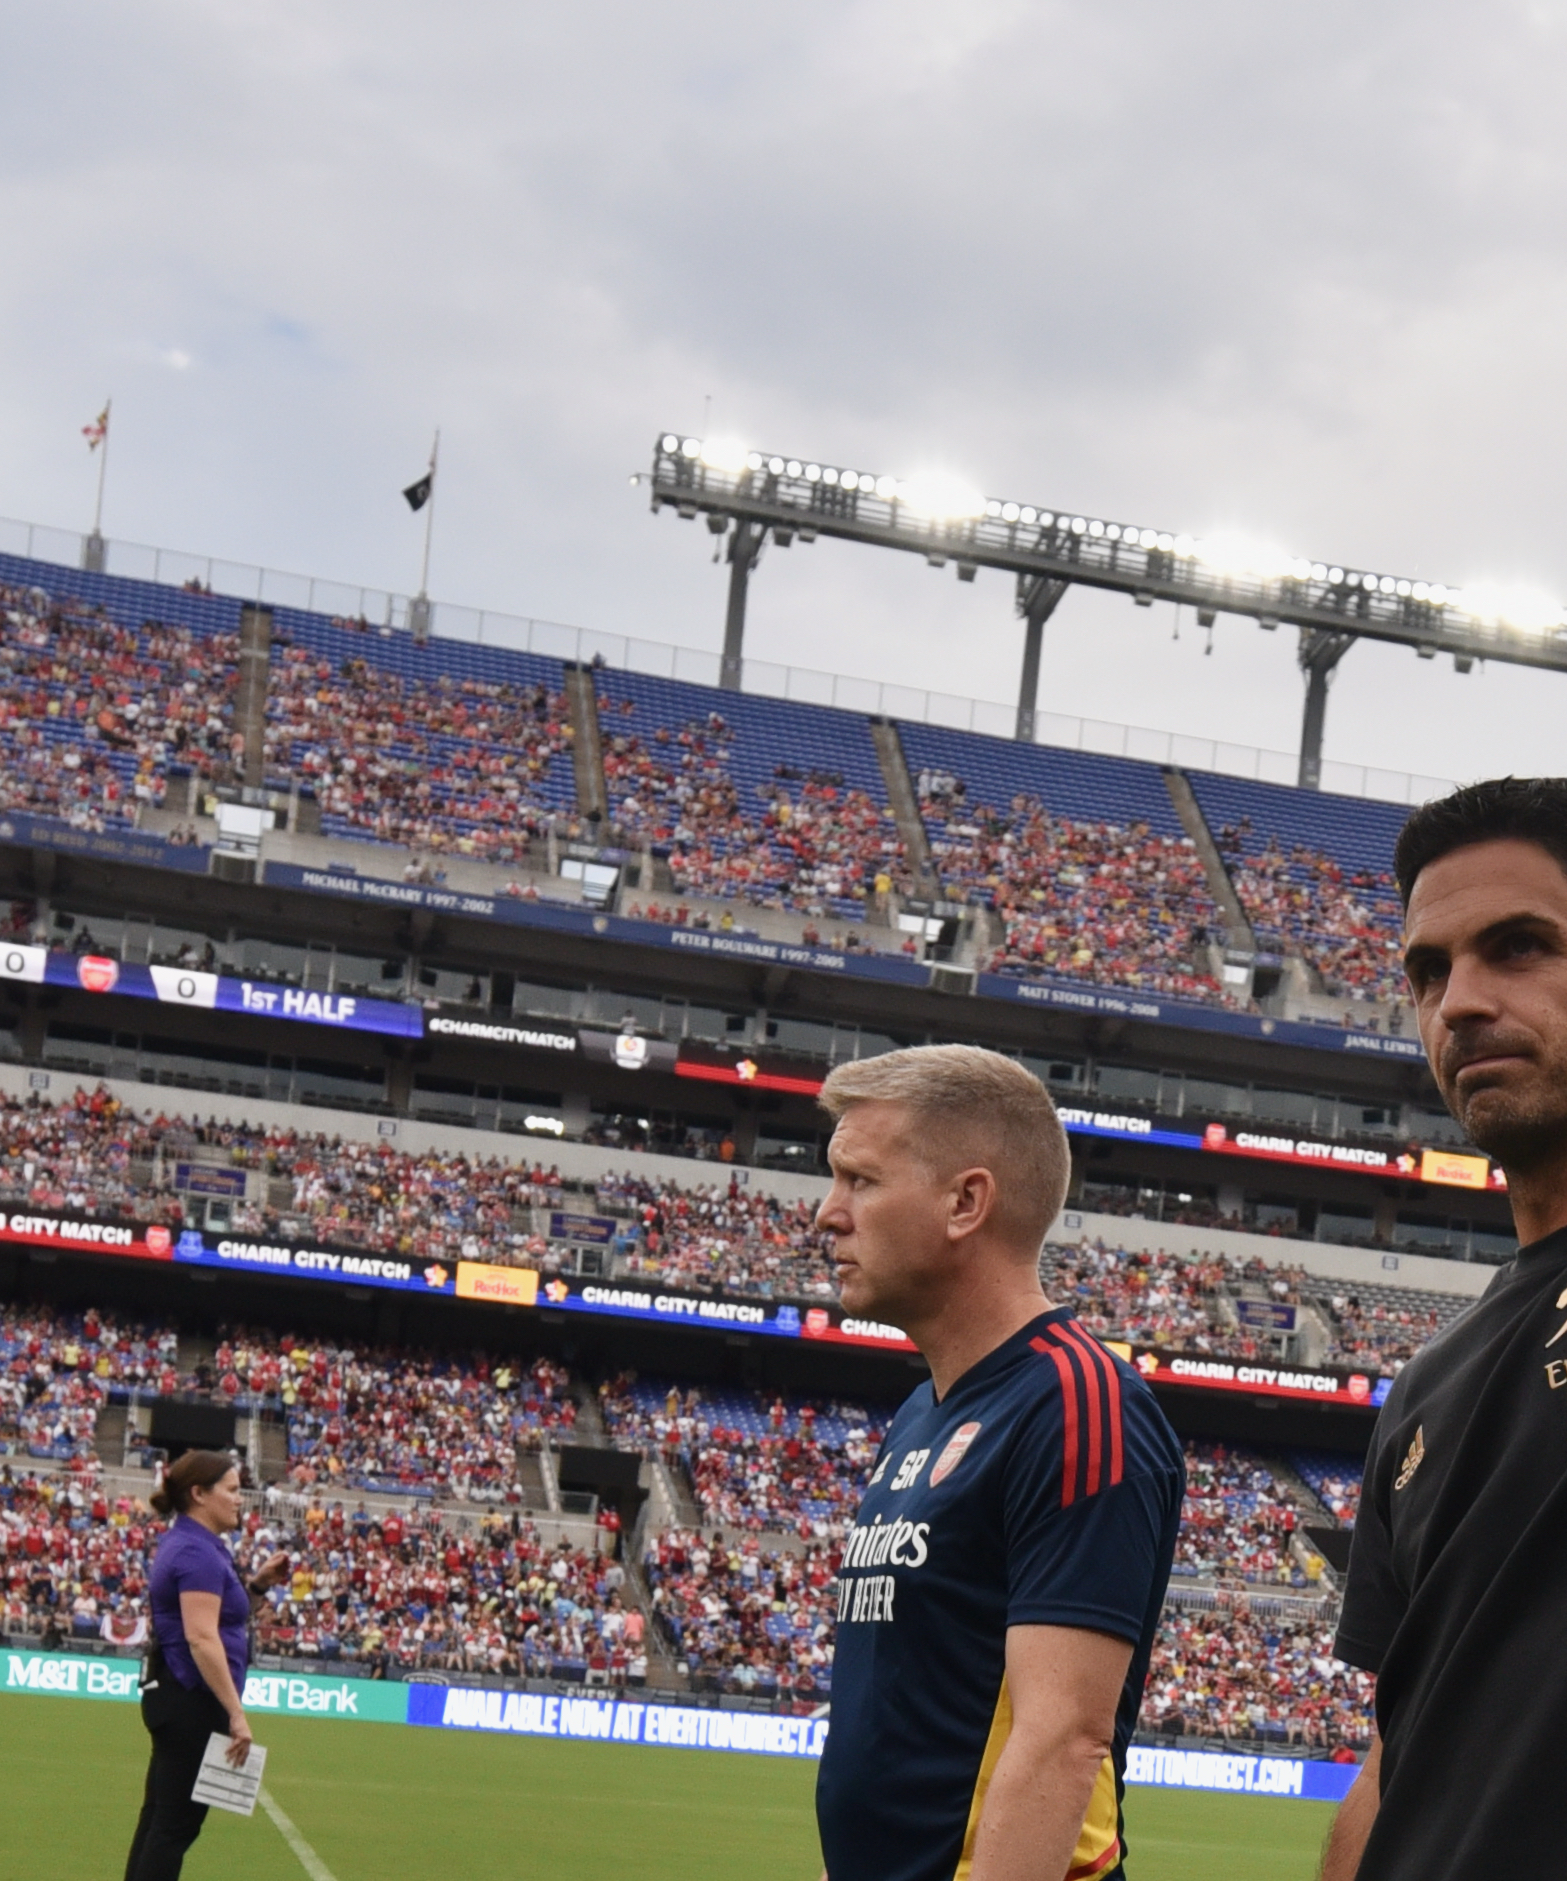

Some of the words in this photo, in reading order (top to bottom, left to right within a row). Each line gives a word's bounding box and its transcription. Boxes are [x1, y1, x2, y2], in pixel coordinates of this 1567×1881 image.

[302, 871, 360, 893] MICHAEL
[425, 891, 495, 914] 1997-2002
[671, 931, 711, 949] PETER
[5, 951, 24, 974] 0
[177, 977, 196, 999] 0
[241, 982, 280, 1011] 1ST
[282, 988, 357, 1023] HALF
[1016, 984, 1050, 1002] MATT
[429, 1018, 577, 1052] #CHARMCITYMATCH
[1344, 1034, 1381, 1051] JAMAL
[1383, 1040, 1419, 1056] LEWIS
[1056, 1106, 1094, 1128] CITY
[1093, 1112, 1151, 1134] MATCH
[1235, 1132, 1295, 1154] CHARM
[1296, 1141, 1334, 1161] CITY
[1332, 1147, 1388, 1166] MATCH
[8, 1214, 59, 1239] CITY
[58, 1220, 133, 1246] MATCH
[216, 1240, 292, 1265] CHARM
[293, 1250, 342, 1273] CITY
[340, 1256, 411, 1281] MATCH
[580, 1285, 652, 1310] CHARM
[653, 1294, 699, 1317] CITY
[697, 1300, 765, 1325] MATCH
[1170, 1358, 1235, 1382] CHARM
[1236, 1367, 1279, 1387] CITY
[1276, 1372, 1338, 1394] MATCH
[890, 1448, 931, 1490] SR
[840, 1513, 931, 1569] mirates
[6, 1654, 88, 1692] M&T
[87, 1661, 140, 1697] Ban
[240, 1676, 288, 1708] &T
[286, 1678, 358, 1714] Bank
[441, 1686, 560, 1735] AVAILABLE
[558, 1697, 613, 1739] NOW
[612, 1702, 645, 1742] AT
[643, 1705, 830, 1757] EVERTONDIRECT.C
[1122, 1745, 1304, 1796] ERTONDIRECT.COM
